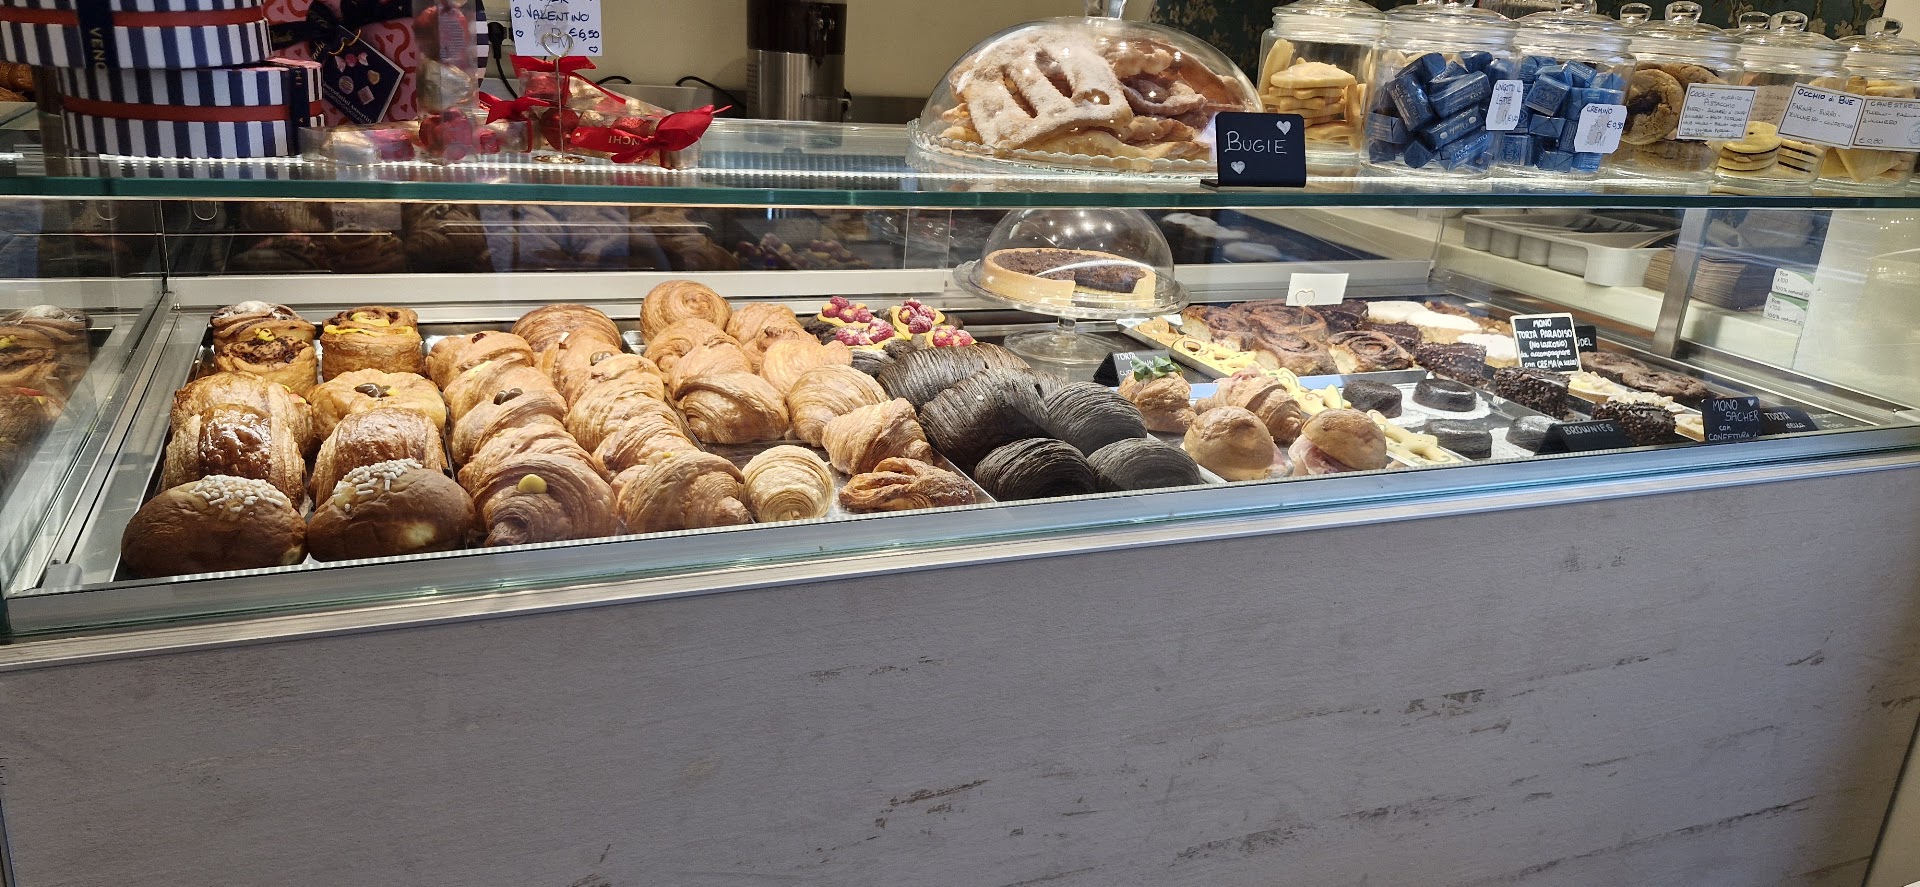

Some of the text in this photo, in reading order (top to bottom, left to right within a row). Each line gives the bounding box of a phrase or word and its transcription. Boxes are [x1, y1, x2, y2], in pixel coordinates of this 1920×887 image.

[526, 4, 589, 21] VALENTINO
[1798, 88, 1826, 100] OCCHIO
[1838, 95, 1855, 106] BUE
[1532, 318, 1552, 329] MONO
[1516, 329, 1573, 340] TORTA PARADISO
[1530, 349, 1571, 359] accompagnare
[1524, 361, 1536, 369] con
[1536, 360, 1557, 369] CREMA
[1712, 399, 1738, 412] MONO
[1724, 409, 1760, 422] SACHER
[1763, 411, 1792, 422] TORTA
[1562, 423, 1614, 436] BROWNIES
